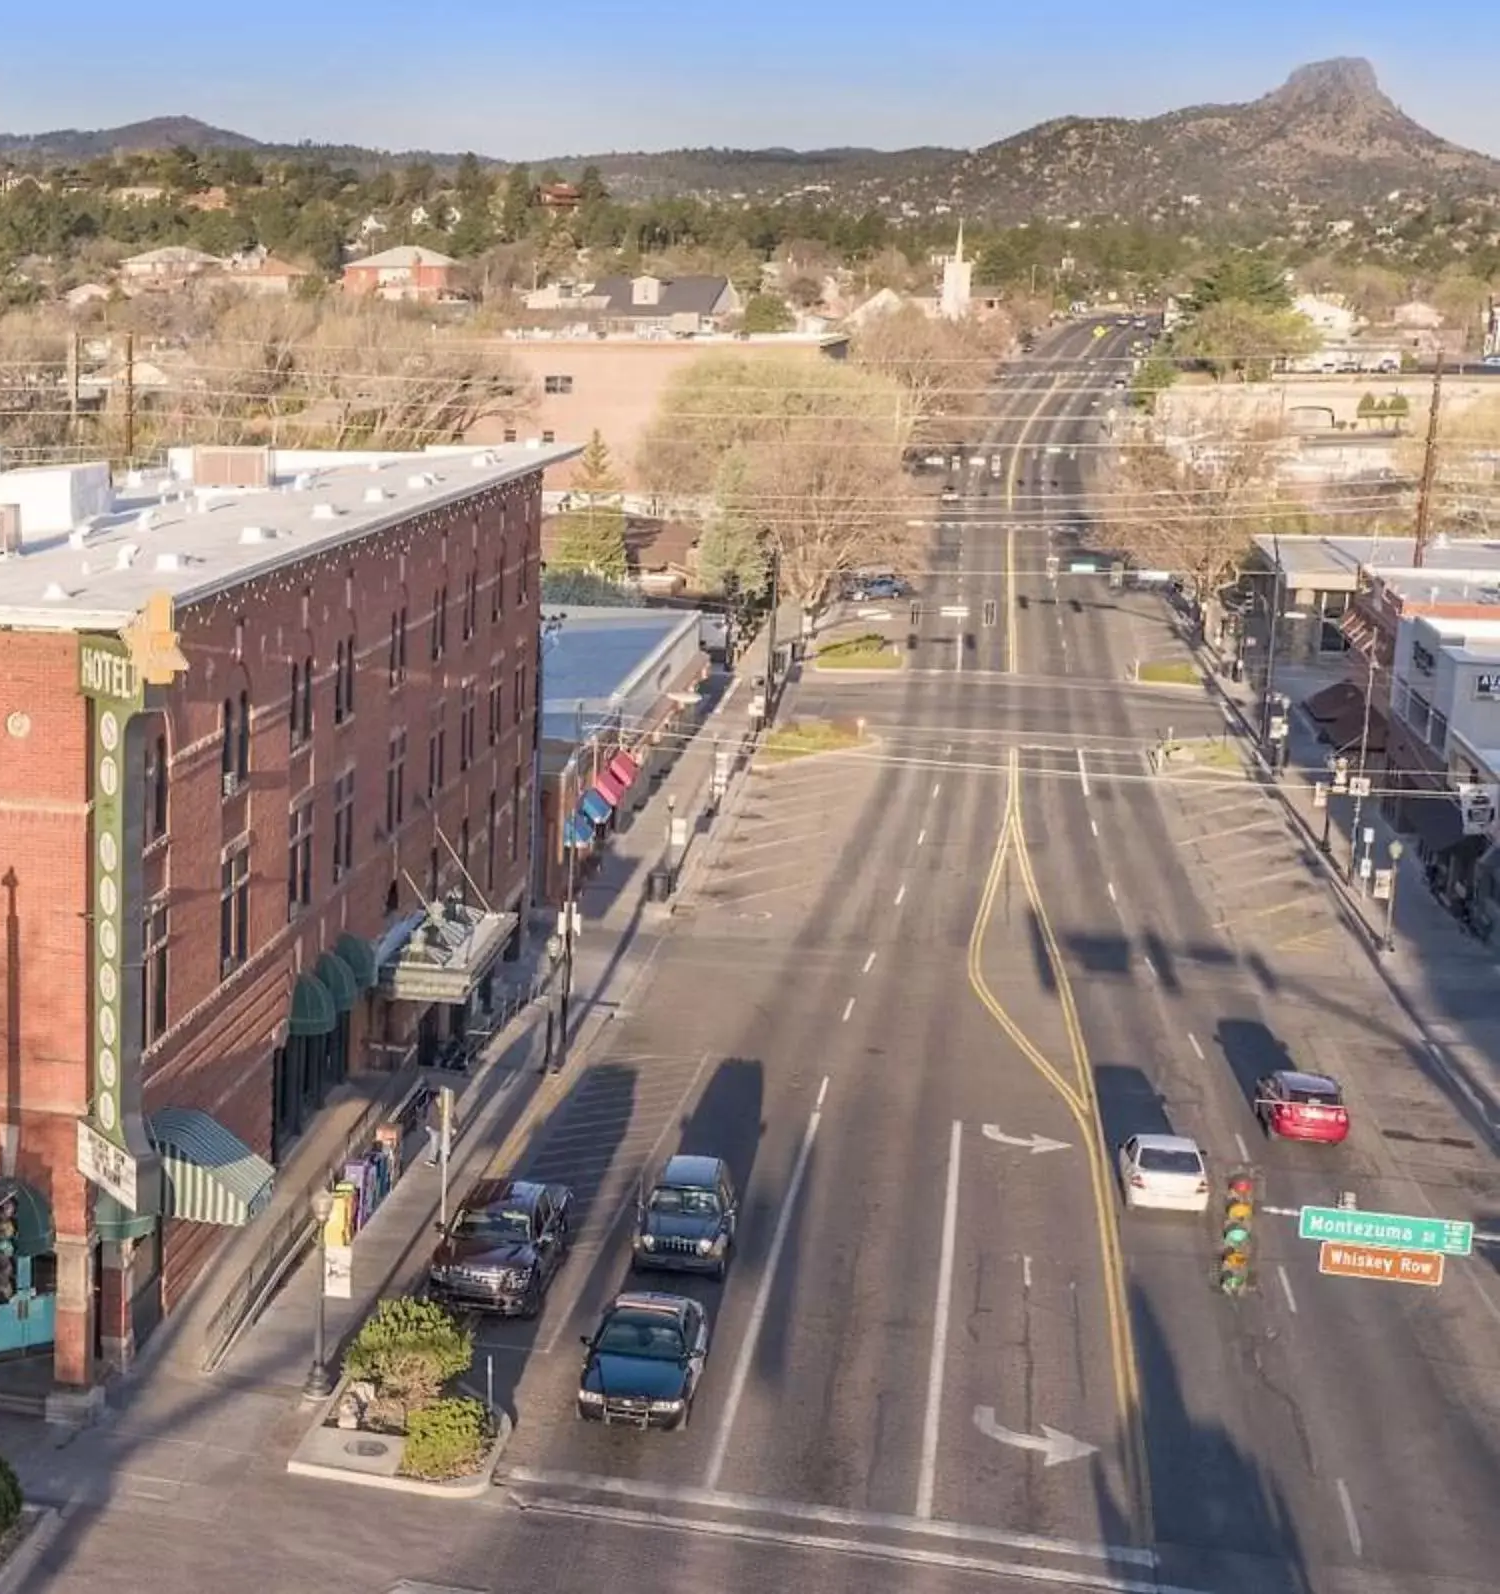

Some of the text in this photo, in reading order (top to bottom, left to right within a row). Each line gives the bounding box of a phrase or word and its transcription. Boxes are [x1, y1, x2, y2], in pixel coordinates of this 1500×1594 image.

[82, 647, 130, 698] HOTEL
[1309, 1214, 1413, 1242] Montezuma
[1330, 1248, 1433, 1275] Whiskey Row
